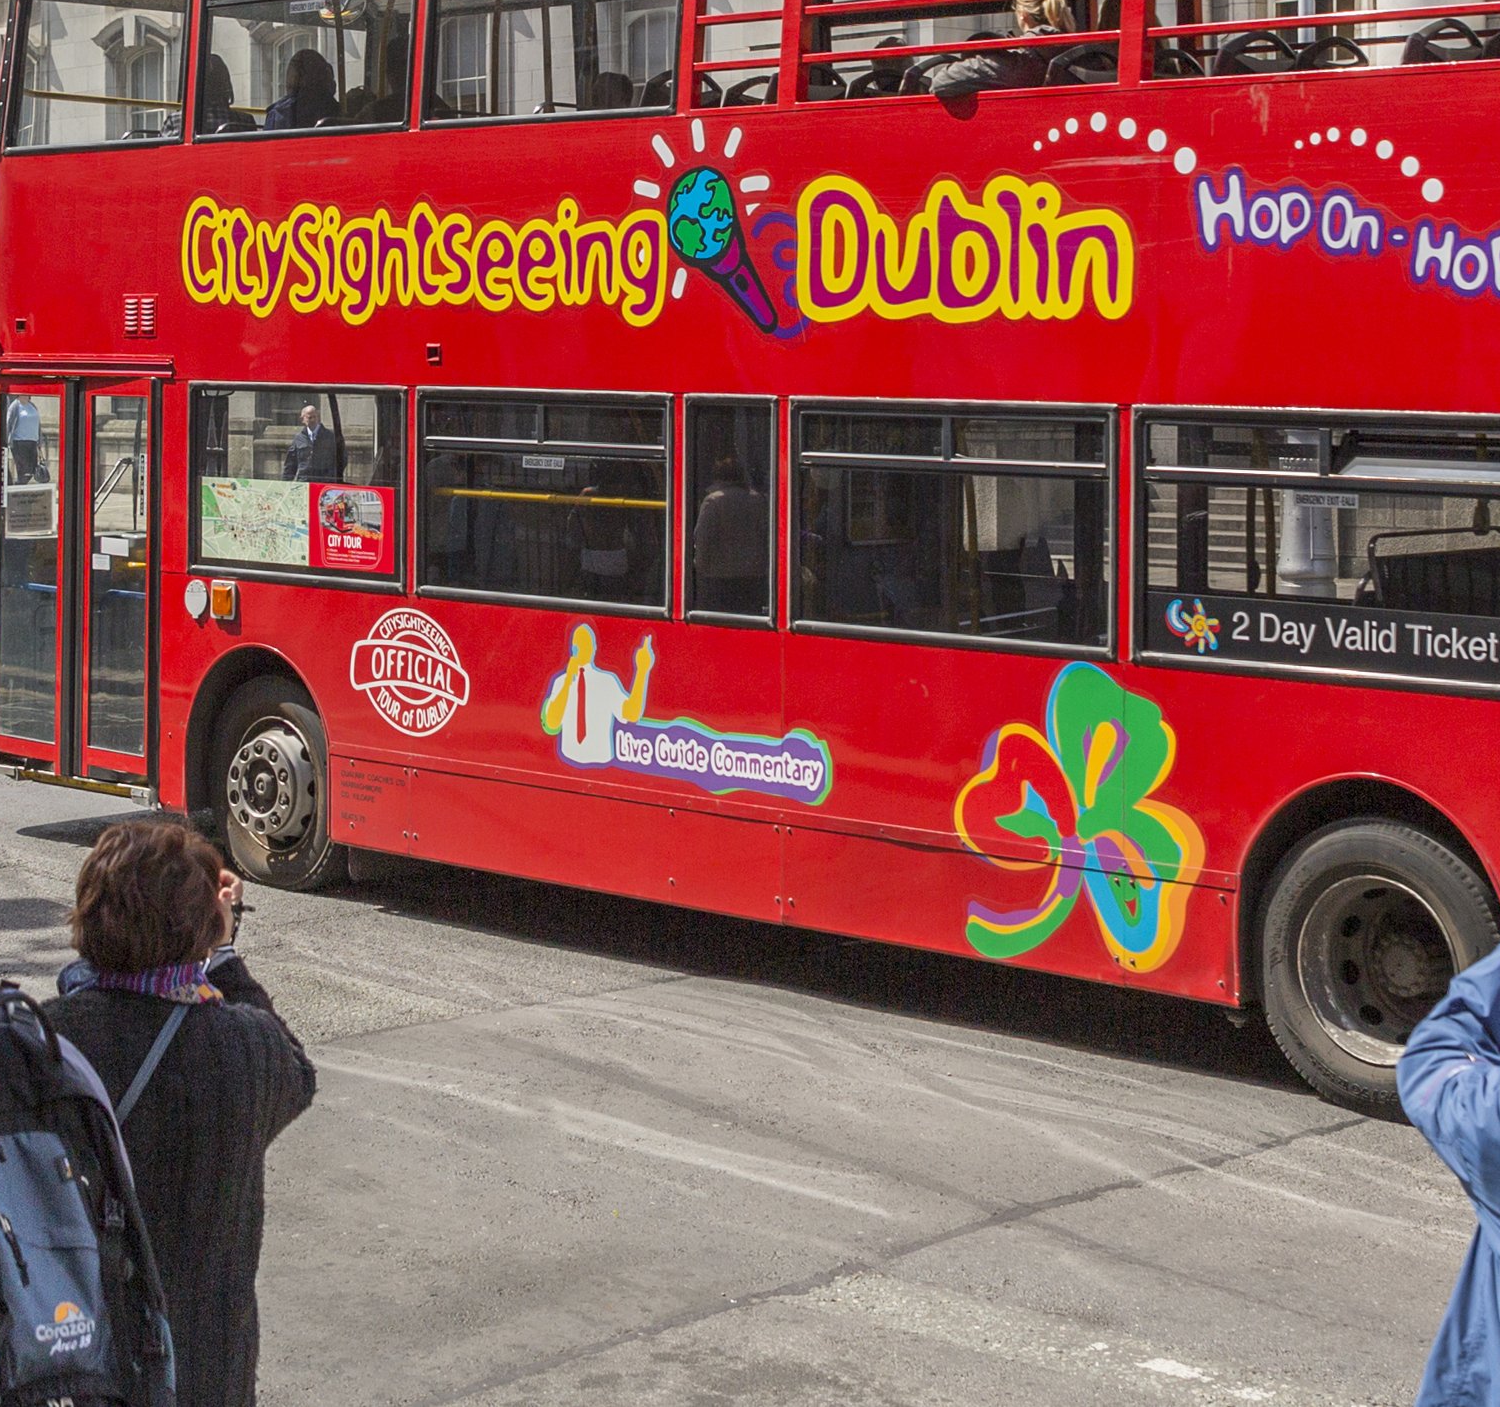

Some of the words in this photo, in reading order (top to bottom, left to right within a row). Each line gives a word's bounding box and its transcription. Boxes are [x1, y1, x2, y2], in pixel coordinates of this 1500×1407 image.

[797, 175, 1134, 324] Dublin
[327, 534, 341, 547] CITY
[343, 535, 362, 549] TOUR
[379, 614, 451, 657] CITYSIGHTSEEING
[1231, 611, 1251, 641] 2
[1259, 612, 1316, 654] Day
[1325, 617, 1397, 653] Valid
[1405, 623, 1499, 663] Ticket
[371, 647, 454, 695] OFFICIAL
[376, 686, 401, 721] TOUR
[402, 709, 414, 727] of
[416, 699, 449, 729] DUBLIN
[615, 730, 653, 765] Live
[655, 733, 709, 773] Guide
[711, 742, 824, 791] Commentary
[36, 1320, 96, 1342] Corazon
